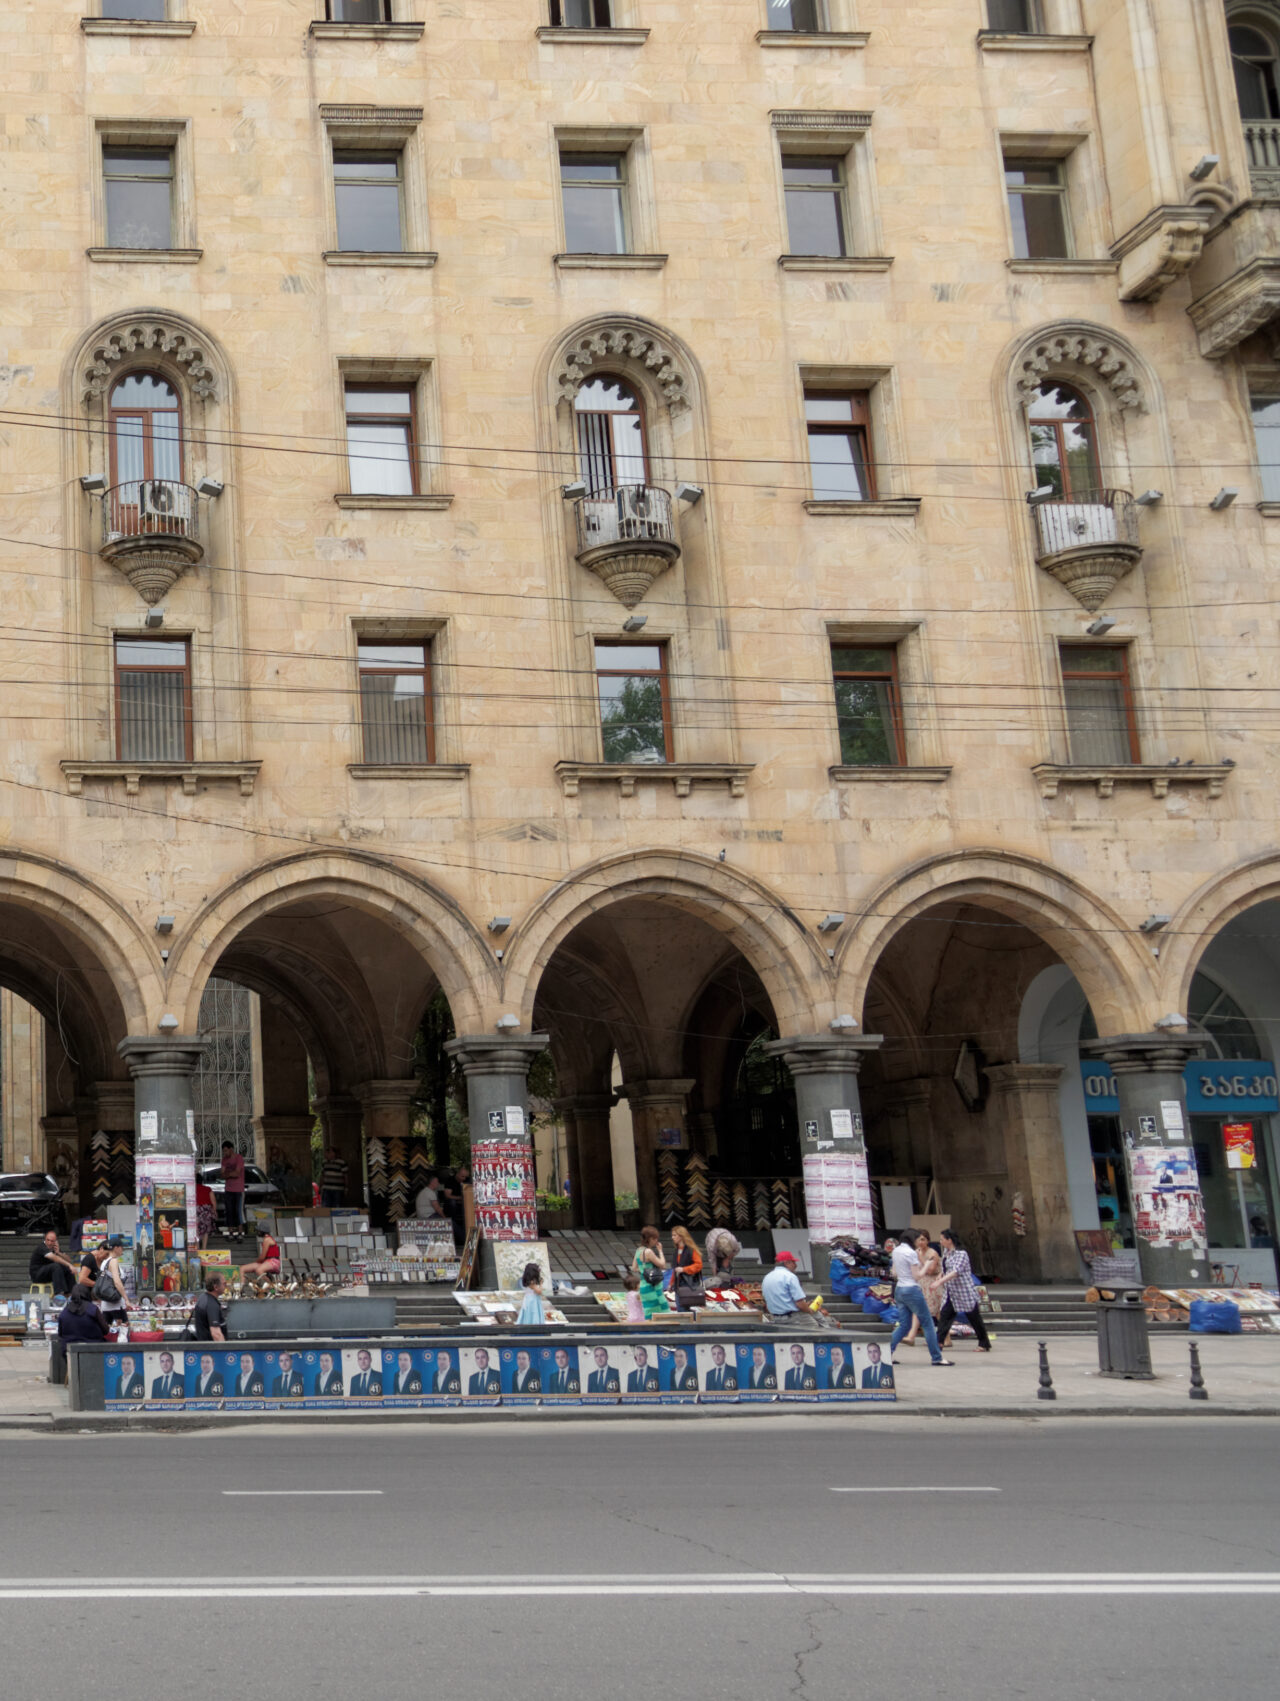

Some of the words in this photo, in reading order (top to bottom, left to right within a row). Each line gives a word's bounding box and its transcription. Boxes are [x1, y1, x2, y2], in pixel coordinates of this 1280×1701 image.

[1200, 1075, 1279, 1097] ბანკი
[726, 1380, 735, 1388] 41
[766, 1377, 774, 1385] 41
[805, 1379, 813, 1387] 41
[845, 1377, 853, 1385] 41
[883, 1379, 891, 1387] 41
[213, 1386, 222, 1394] 41
[253, 1385, 262, 1393] 41
[293, 1386, 301, 1394] 41
[333, 1384, 342, 1392] 41
[371, 1385, 380, 1394] 41
[412, 1383, 420, 1391] 41
[450, 1382, 459, 1391] 41
[489, 1384, 498, 1392] 41
[530, 1382, 539, 1390] 41
[569, 1382, 577, 1390] 41
[608, 1382, 616, 1391] 41
[648, 1382, 656, 1390] 41
[134, 1387, 143, 1395] 41
[173, 1388, 181, 1396] 41
